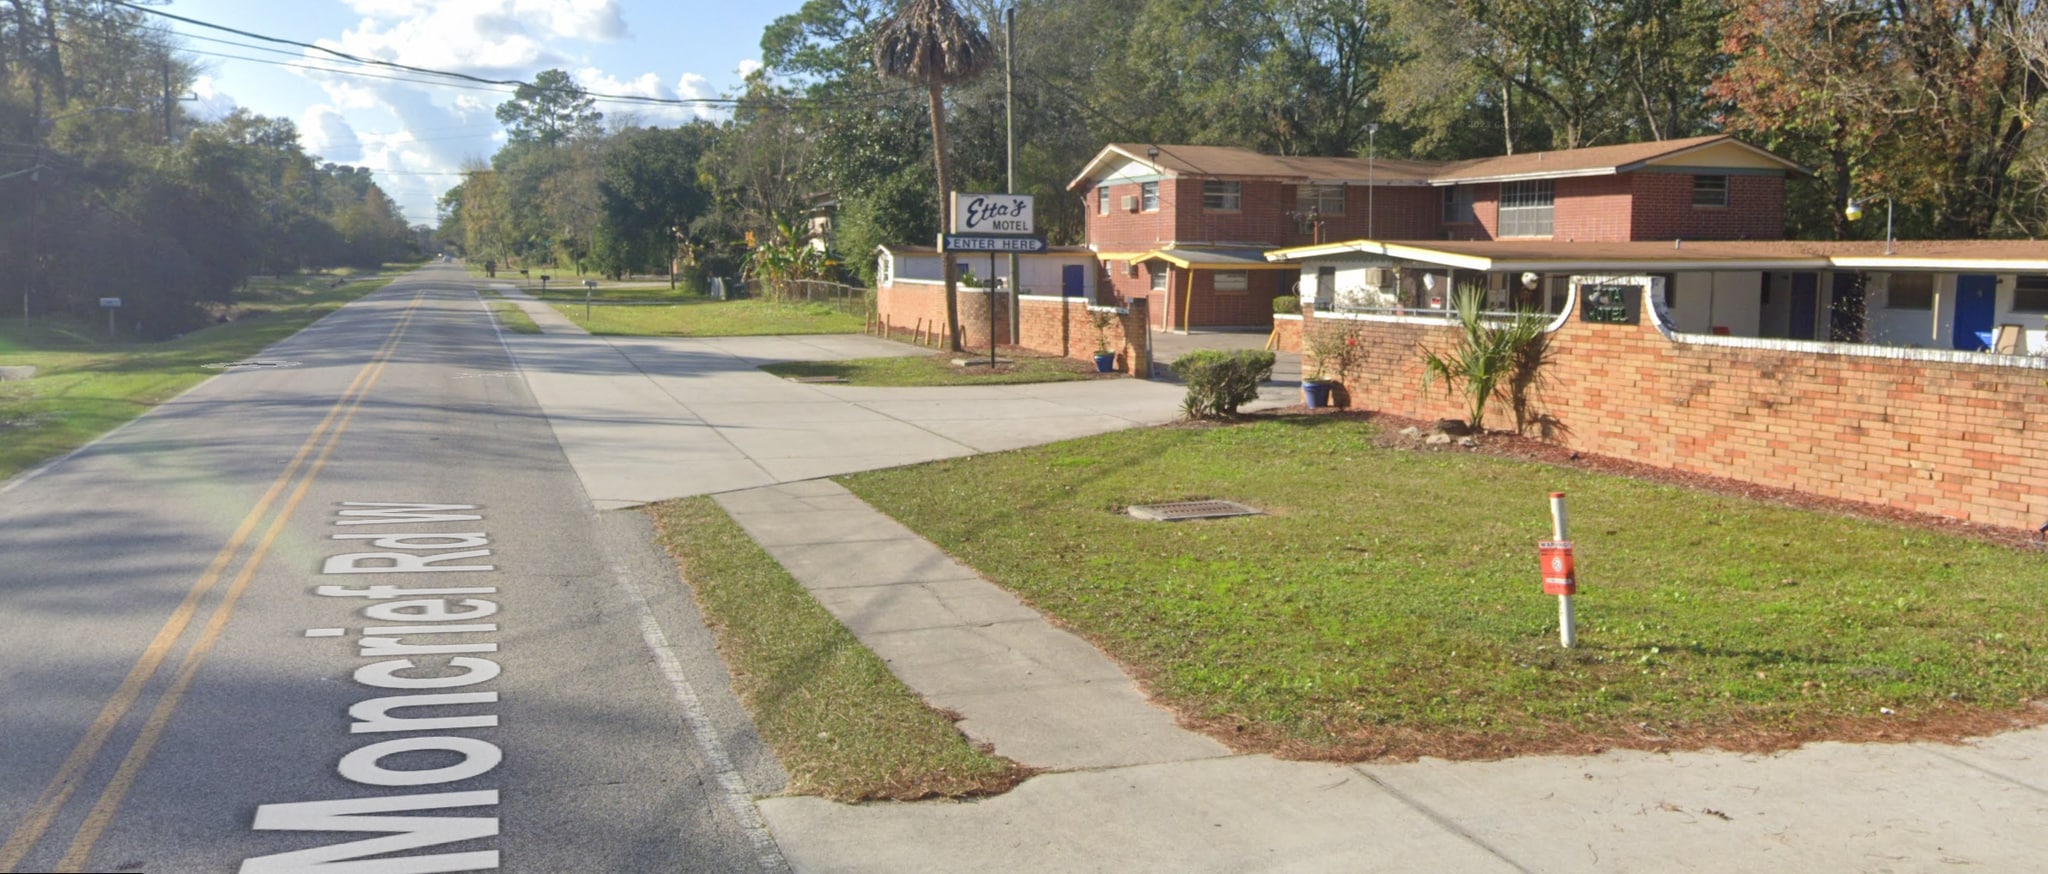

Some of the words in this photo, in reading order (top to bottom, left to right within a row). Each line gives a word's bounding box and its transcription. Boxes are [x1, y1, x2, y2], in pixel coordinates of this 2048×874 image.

[966, 198, 1027, 228] Etta's
[993, 221, 1028, 231] MOTEL
[953, 239, 995, 249] ENTER
[1003, 240, 1037, 250] HERE
